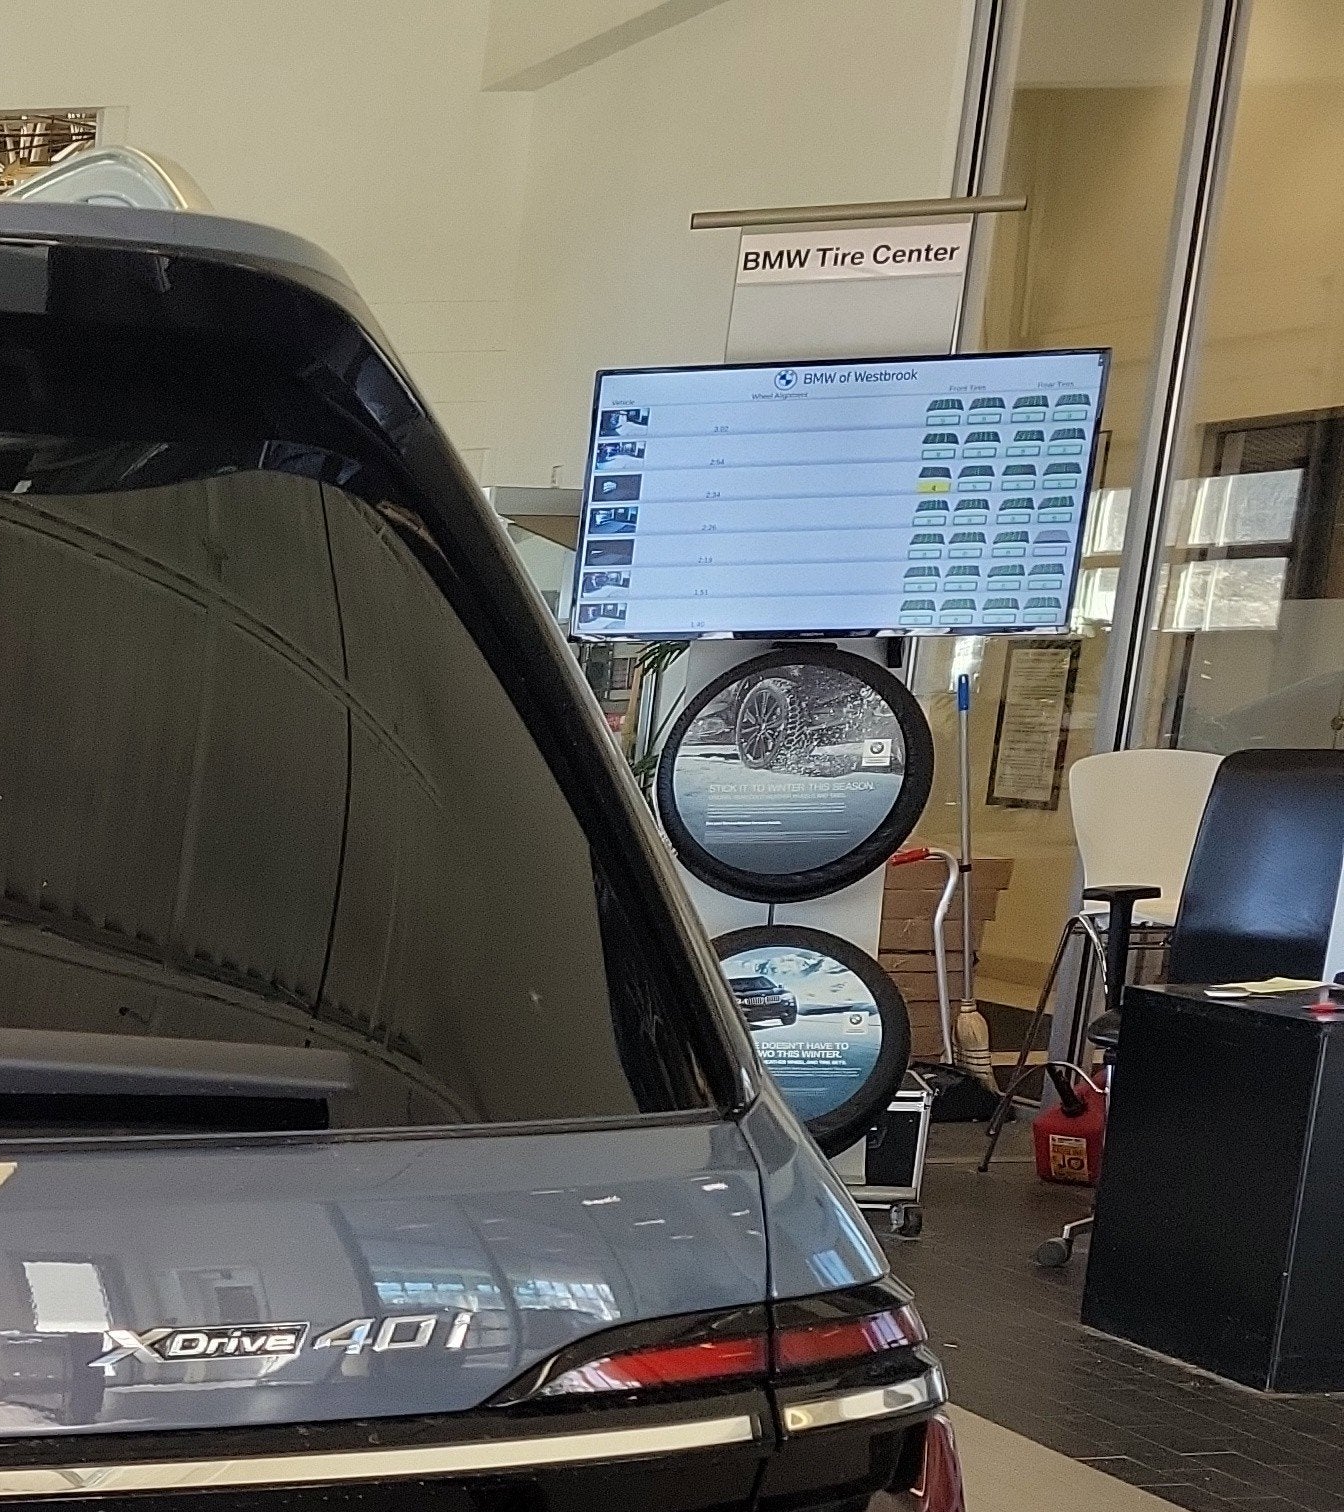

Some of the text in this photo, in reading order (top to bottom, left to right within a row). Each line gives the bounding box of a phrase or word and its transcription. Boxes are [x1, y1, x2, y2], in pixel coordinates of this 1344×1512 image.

[742, 244, 960, 271] BMW Tire Center
[803, 369, 918, 385] BMW of Westbrook
[709, 784, 737, 793] STICK
[753, 784, 765, 792] TO
[768, 784, 805, 792] WINTER
[810, 783, 830, 791] THIS
[832, 782, 875, 791] SEASON.
[761, 1042, 805, 1050] DOESN'T
[806, 1042, 830, 1050] HAVE
[834, 1042, 849, 1050] TO
[776, 1050, 800, 1058] THIS
[801, 1050, 843, 1058] WINTER.
